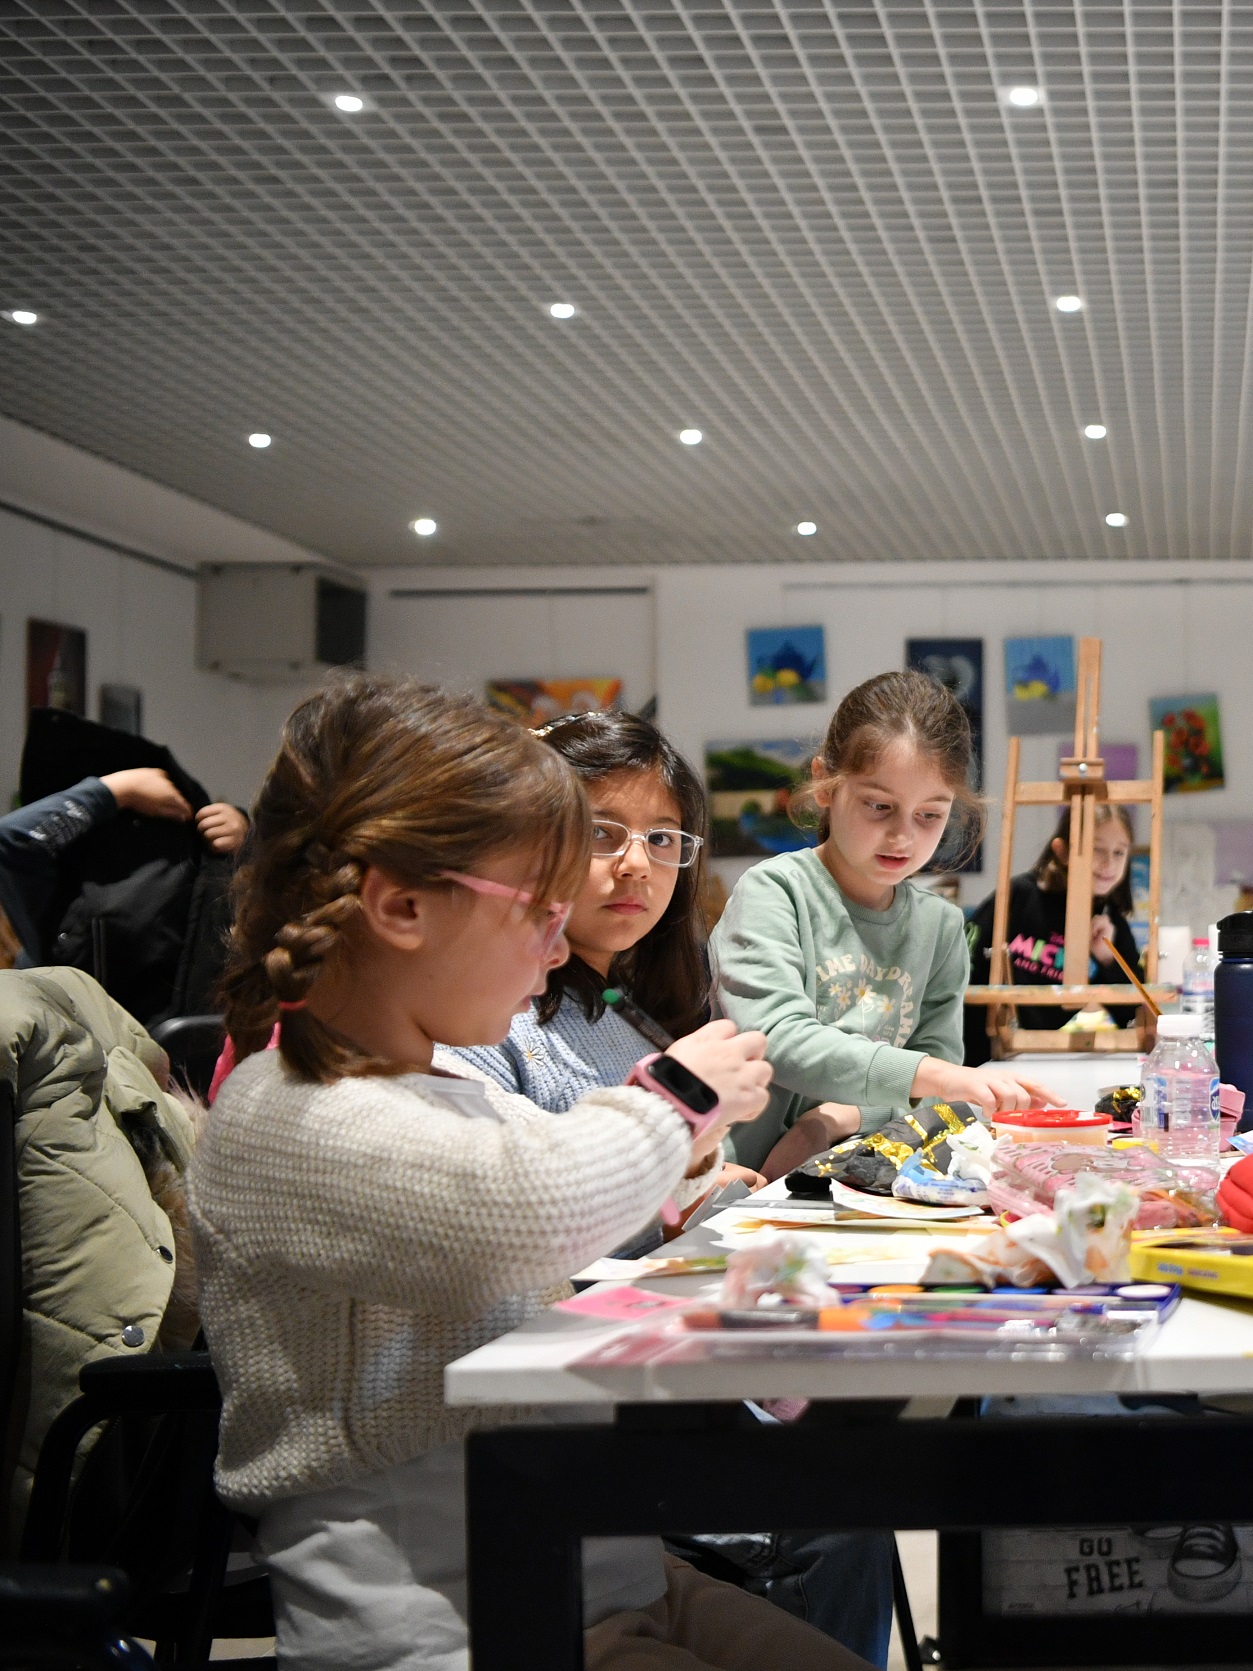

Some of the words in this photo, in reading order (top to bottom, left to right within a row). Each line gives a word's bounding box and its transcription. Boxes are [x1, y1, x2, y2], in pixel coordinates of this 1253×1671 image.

[815, 953, 856, 982] IME
[1079, 1536, 1113, 1557] GO
[1064, 1555, 1144, 1600] FREE
